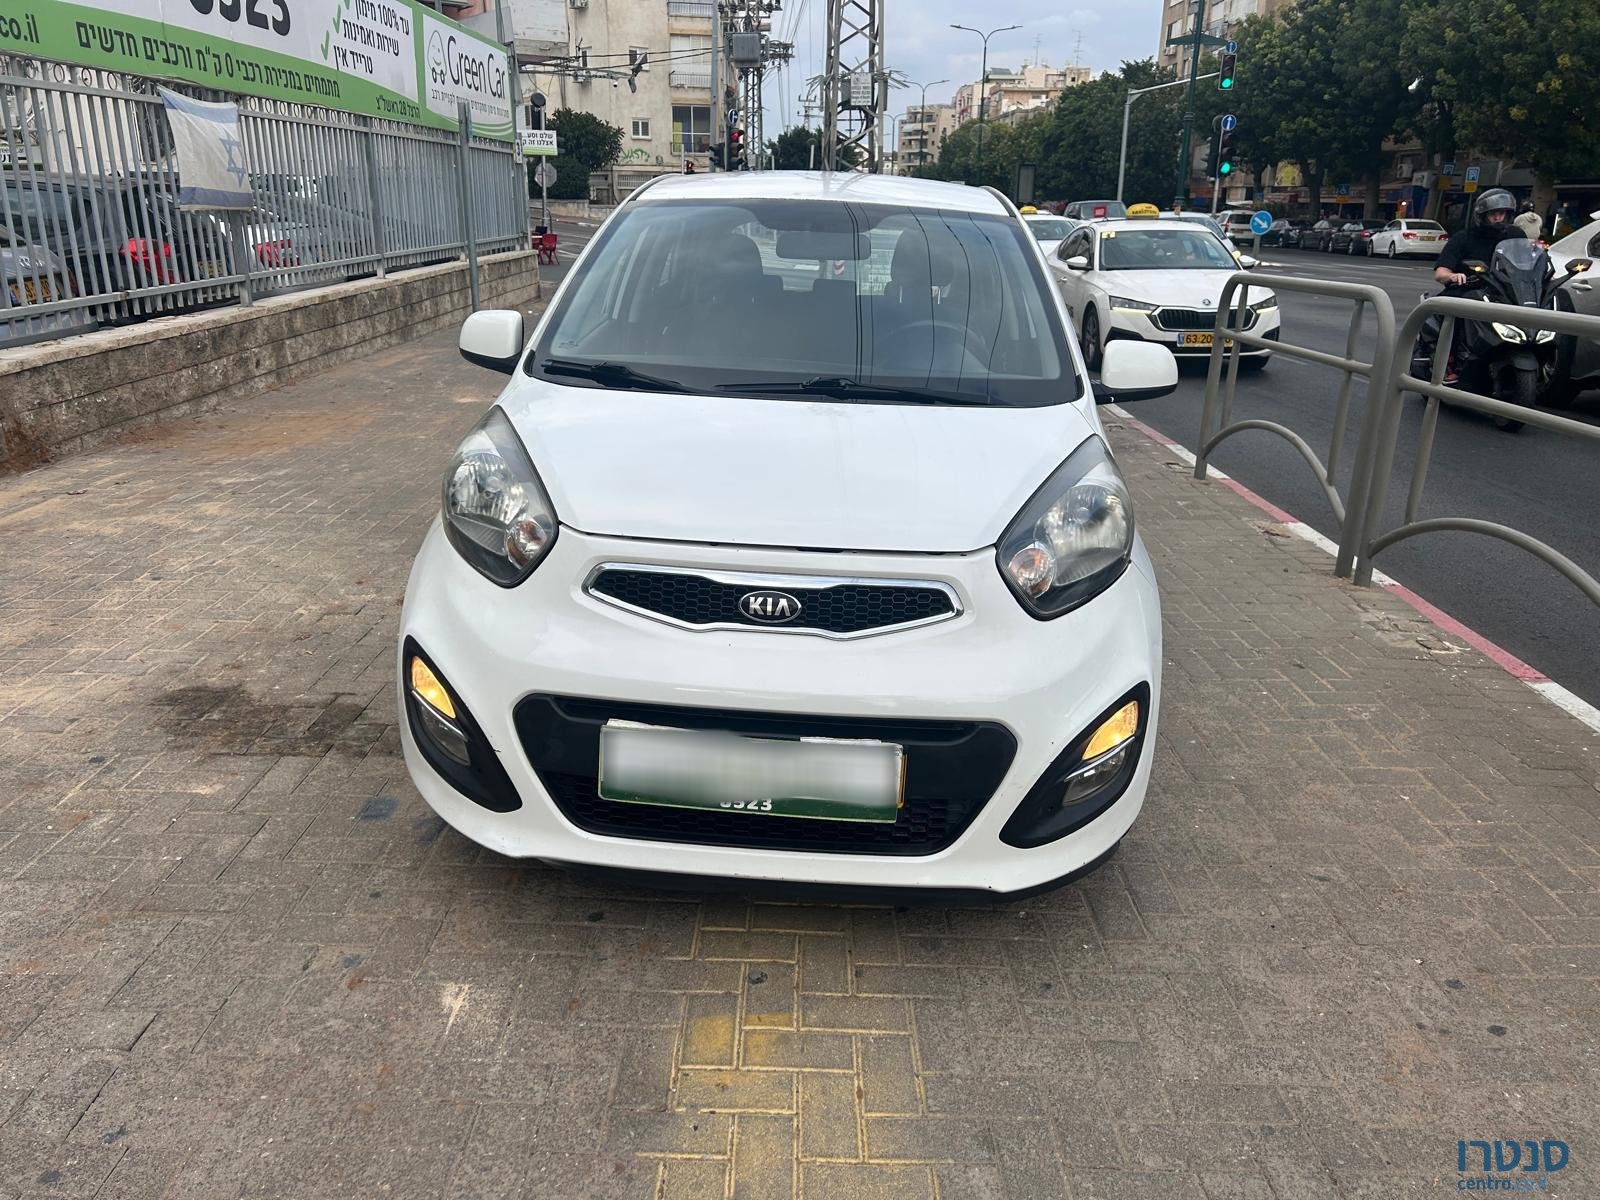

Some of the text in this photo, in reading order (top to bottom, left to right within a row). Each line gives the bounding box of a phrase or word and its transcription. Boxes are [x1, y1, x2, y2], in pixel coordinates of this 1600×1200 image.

[355, 0, 377, 21] מימון
[75, 21, 140, 58] חדשים
[343, 19, 399, 56] שירות ואמינות
[400, 17, 410, 36] עד
[142, 36, 193, 69] ורכבים
[224, 52, 234, 78] 0
[333, 45, 373, 74] טרייד אין
[235, 59, 263, 84] רכבי
[264, 64, 303, 91] במכירת
[447, 35, 506, 99] Green Car
[303, 74, 341, 98] מתמחים
[749, 596, 791, 617] KIA
